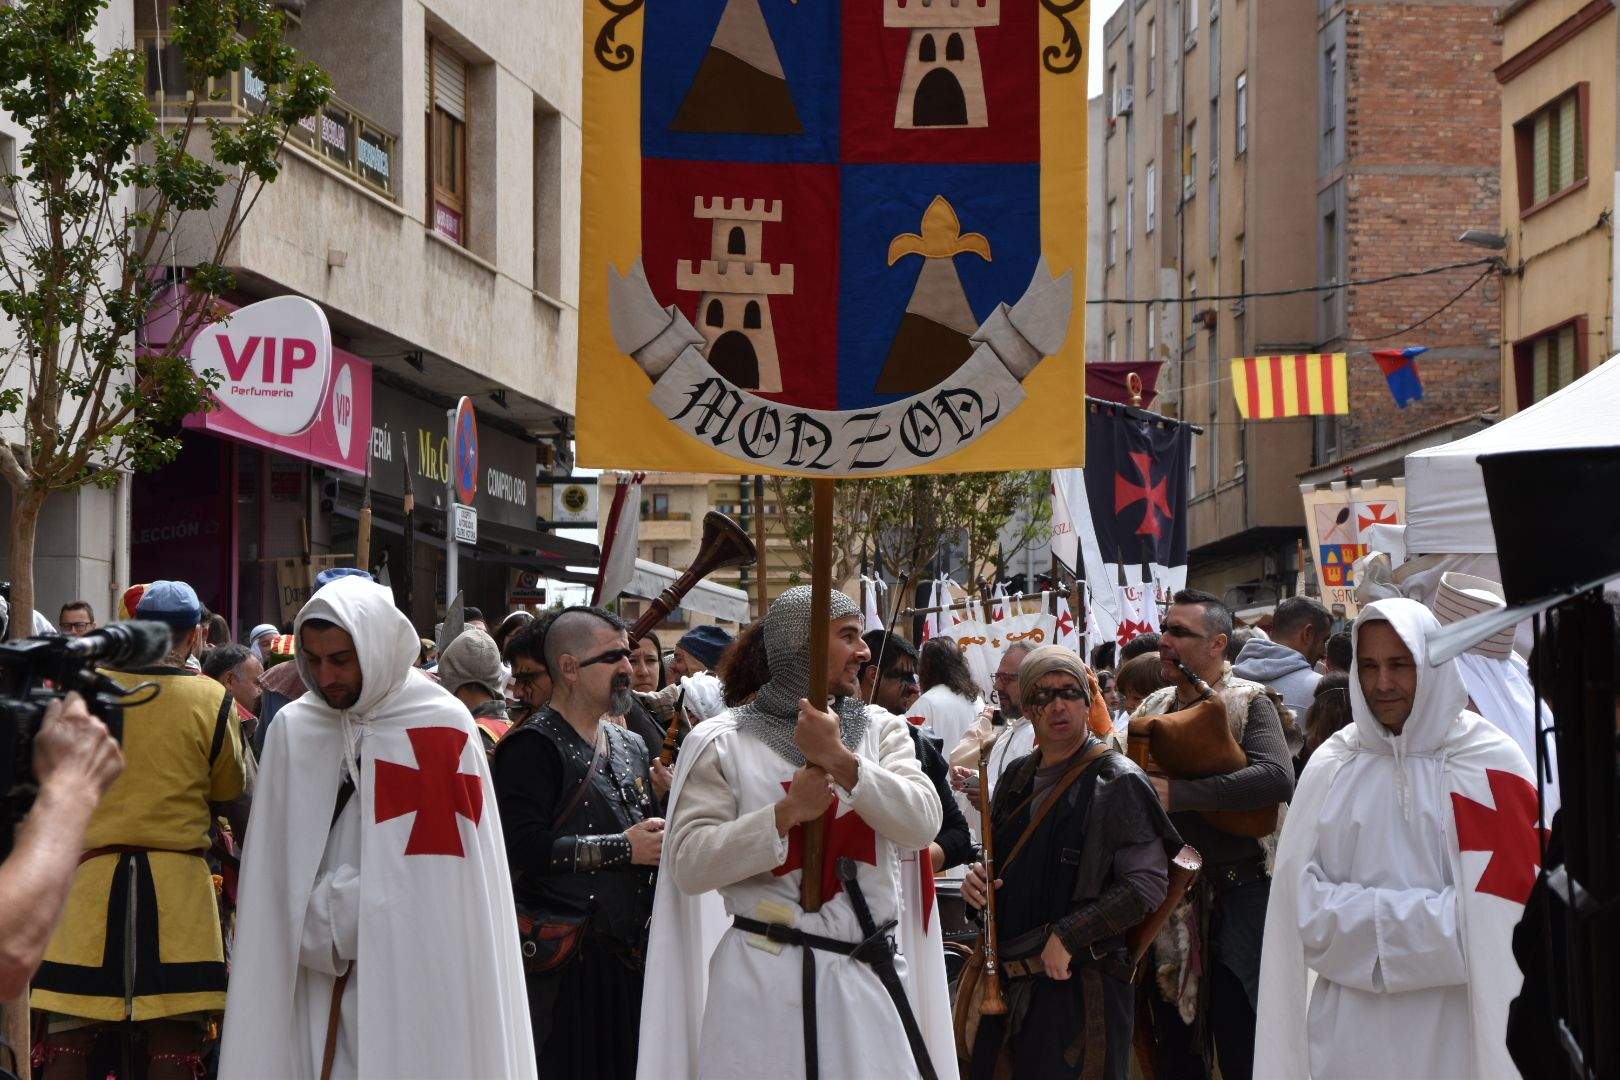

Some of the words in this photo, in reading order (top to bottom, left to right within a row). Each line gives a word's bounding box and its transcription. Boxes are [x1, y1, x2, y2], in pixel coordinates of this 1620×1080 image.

[216, 335, 317, 384] VIP
[336, 393, 351, 428] VIP
[668, 377, 1000, 472] MONZON
[487, 467, 513, 502] COMPRO
[514, 477, 527, 507] ORO
